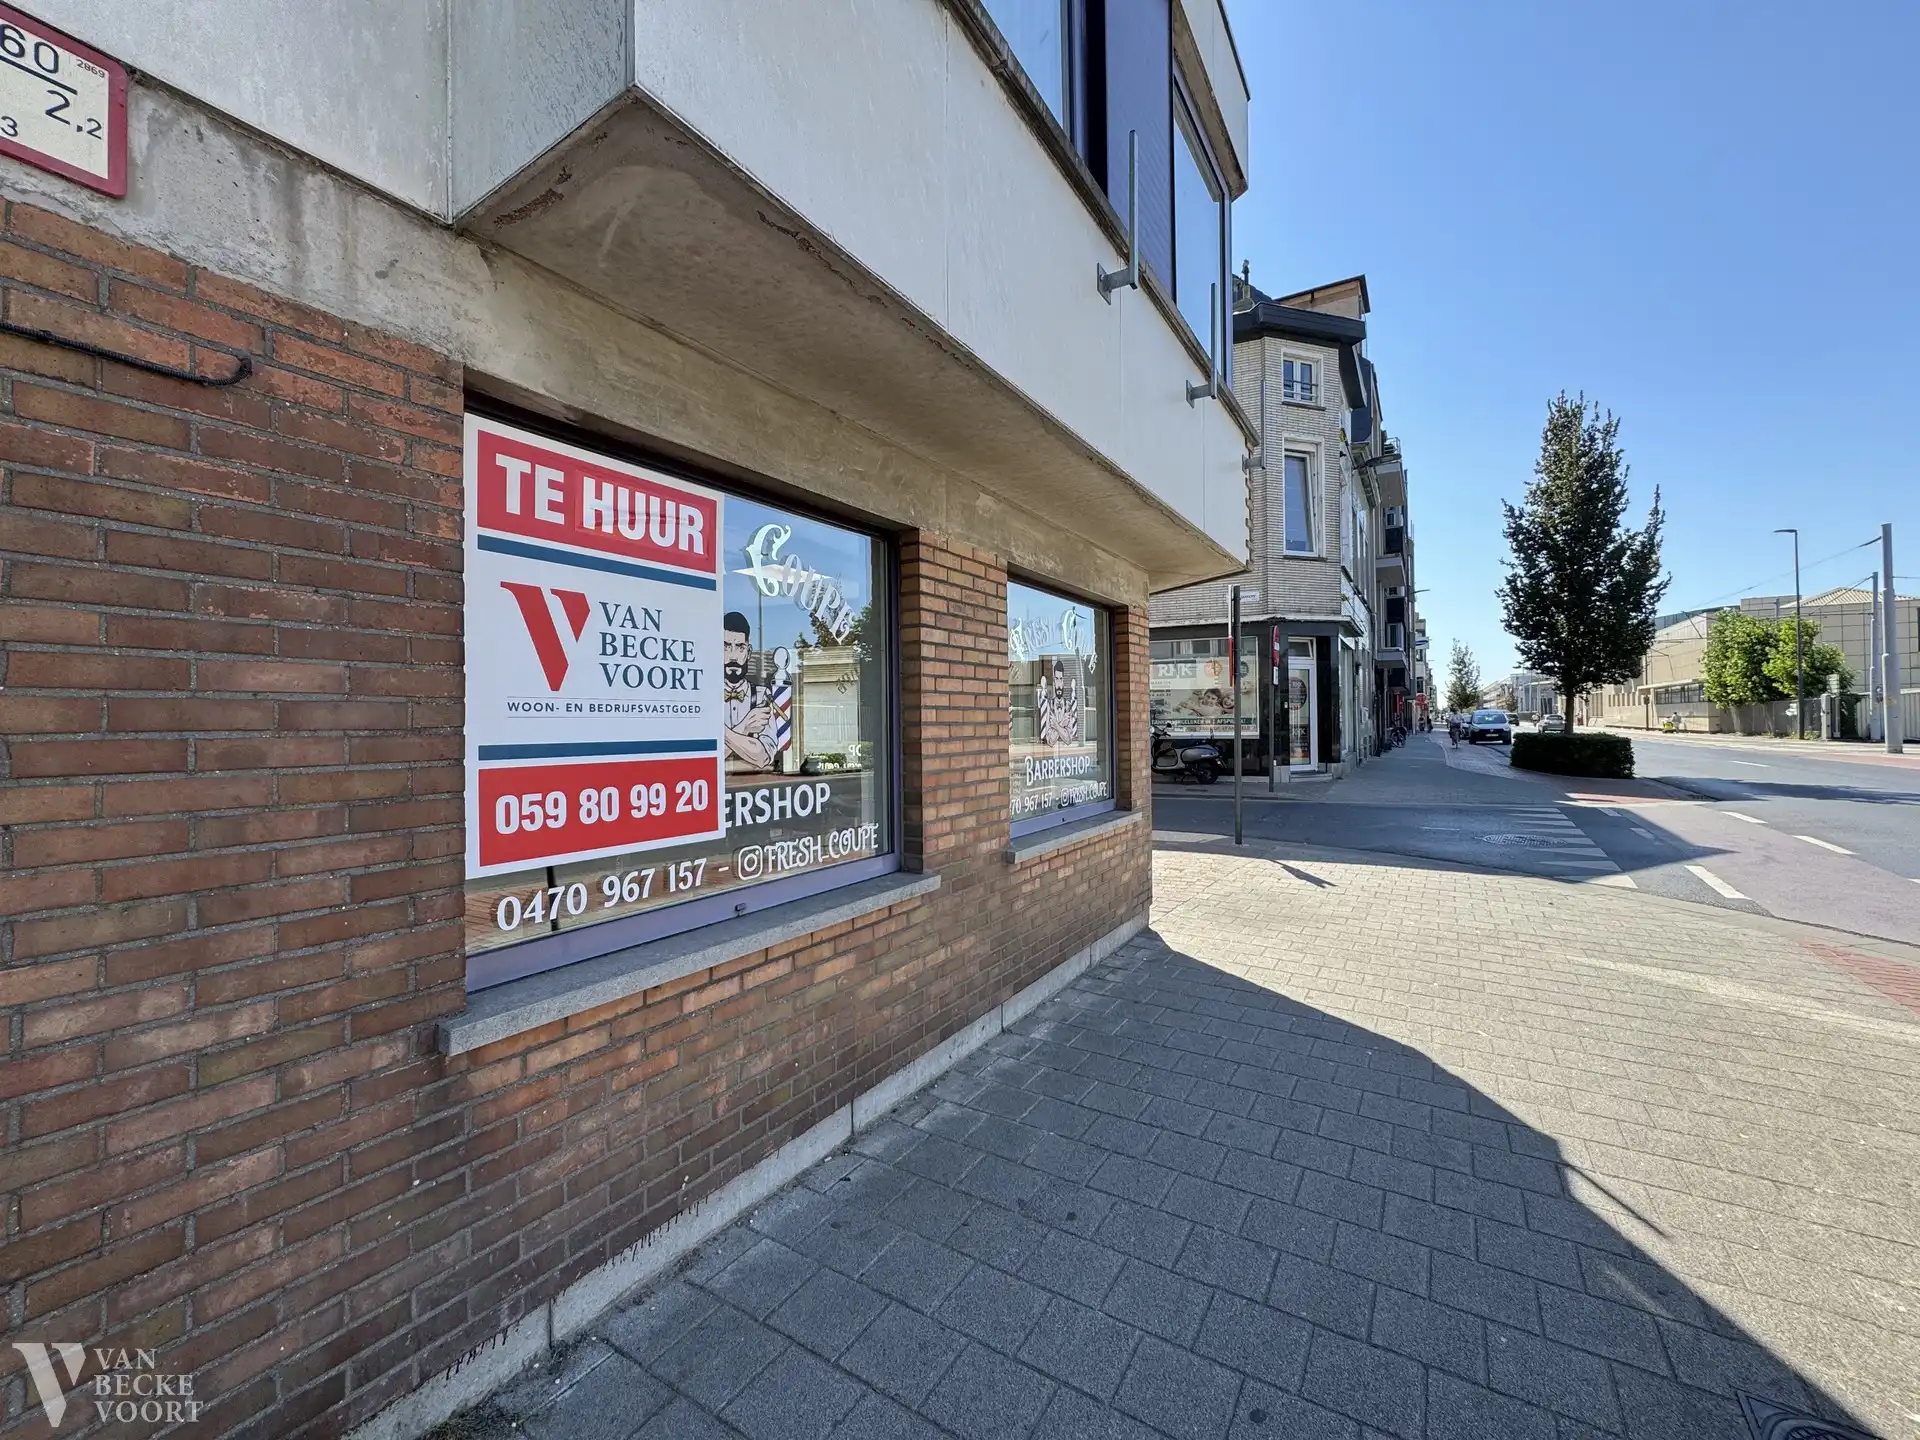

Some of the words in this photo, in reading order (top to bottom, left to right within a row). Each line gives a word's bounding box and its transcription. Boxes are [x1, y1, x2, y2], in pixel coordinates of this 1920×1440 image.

[76, 58, 105, 78] 2869
[496, 453, 565, 525] TE
[583, 476, 704, 555] HUUR
[599, 601, 662, 632] VAN
[599, 632, 695, 663] BECKE
[599, 663, 703, 690] VOORT
[507, 702, 559, 712] WOON-
[566, 703, 583, 712] EN
[589, 704, 701, 714] BEDRIJFSVASTGOED
[1025, 756, 1091, 786] BARBERSHOP
[496, 791, 567, 834] 059
[579, 786, 620, 825] 80
[630, 783, 666, 818] 99
[675, 779, 708, 812] 20
[1025, 795, 1039, 812] 967
[1041, 792, 1053, 808] 157
[497, 882, 588, 931] 0470
[602, 868, 656, 908] 967
[667, 858, 707, 892] 157
